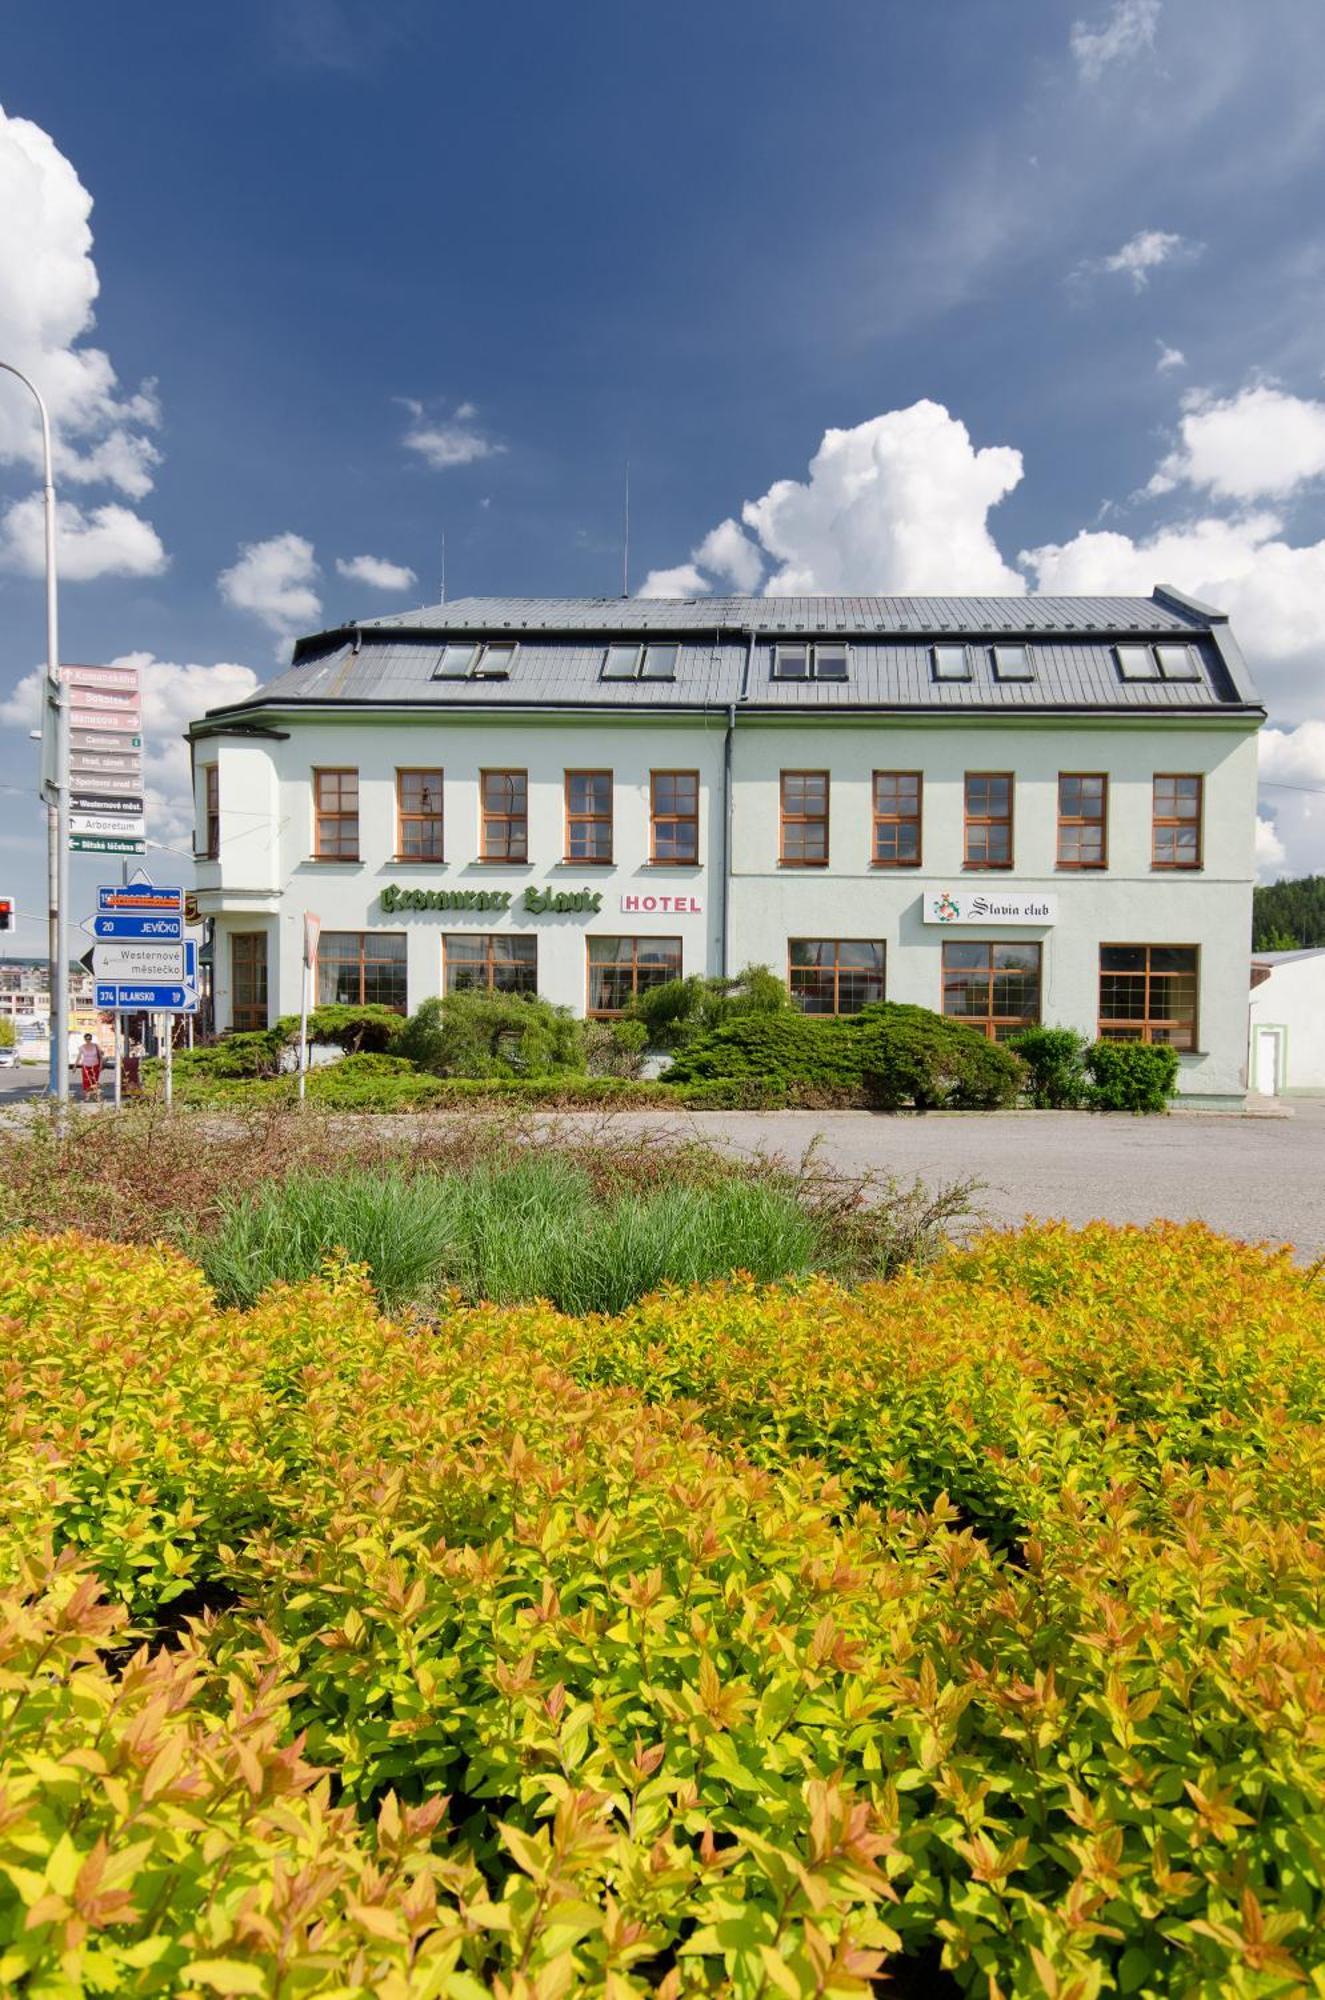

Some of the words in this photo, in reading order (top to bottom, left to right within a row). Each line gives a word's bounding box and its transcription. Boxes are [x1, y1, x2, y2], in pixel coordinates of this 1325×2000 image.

[80, 799, 121, 810] Westernové
[86, 820, 135, 831] Arboretum
[625, 895, 701, 912] HOTEL
[968, 896, 1019, 918] Slavia
[1024, 903, 1049, 915] club
[102, 921, 114, 932] 20
[140, 921, 179, 933] JEVÍČKO
[121, 950, 180, 960] Westernové
[132, 963, 180, 974] městečko
[100, 991, 114, 1000] 374
[120, 991, 155, 1001] BLANSKO
